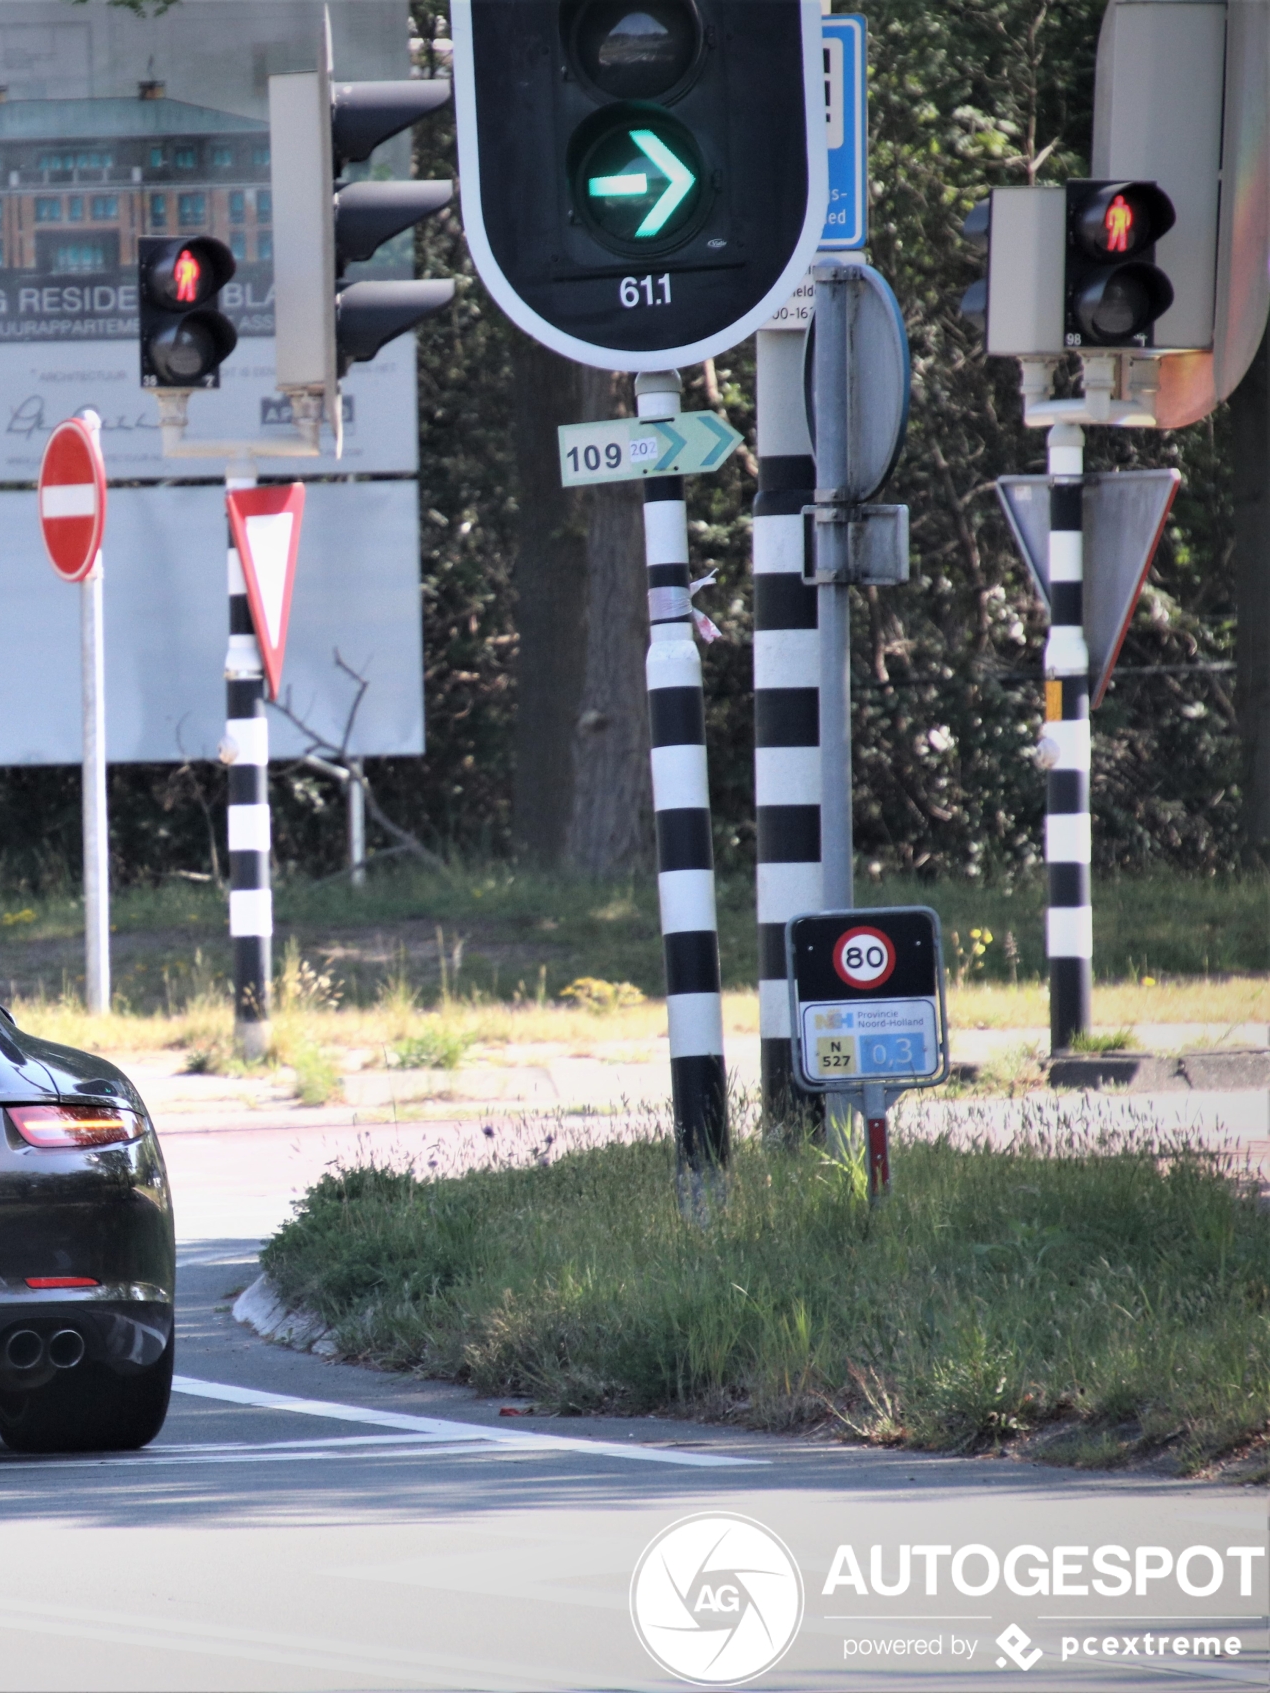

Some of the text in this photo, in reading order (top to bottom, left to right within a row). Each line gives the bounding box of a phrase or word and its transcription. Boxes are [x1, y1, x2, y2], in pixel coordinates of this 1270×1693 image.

[1066, 333, 1082, 346] 98
[143, 374, 158, 387] 38
[566, 443, 623, 473] 109
[846, 946, 884, 969] 80
[858, 1011, 899, 1019] Provincie
[858, 1018, 924, 1028] Noord-Holland
[831, 1041, 842, 1052] N
[872, 1037, 913, 1068] 0,3
[822, 1055, 851, 1067] 527
